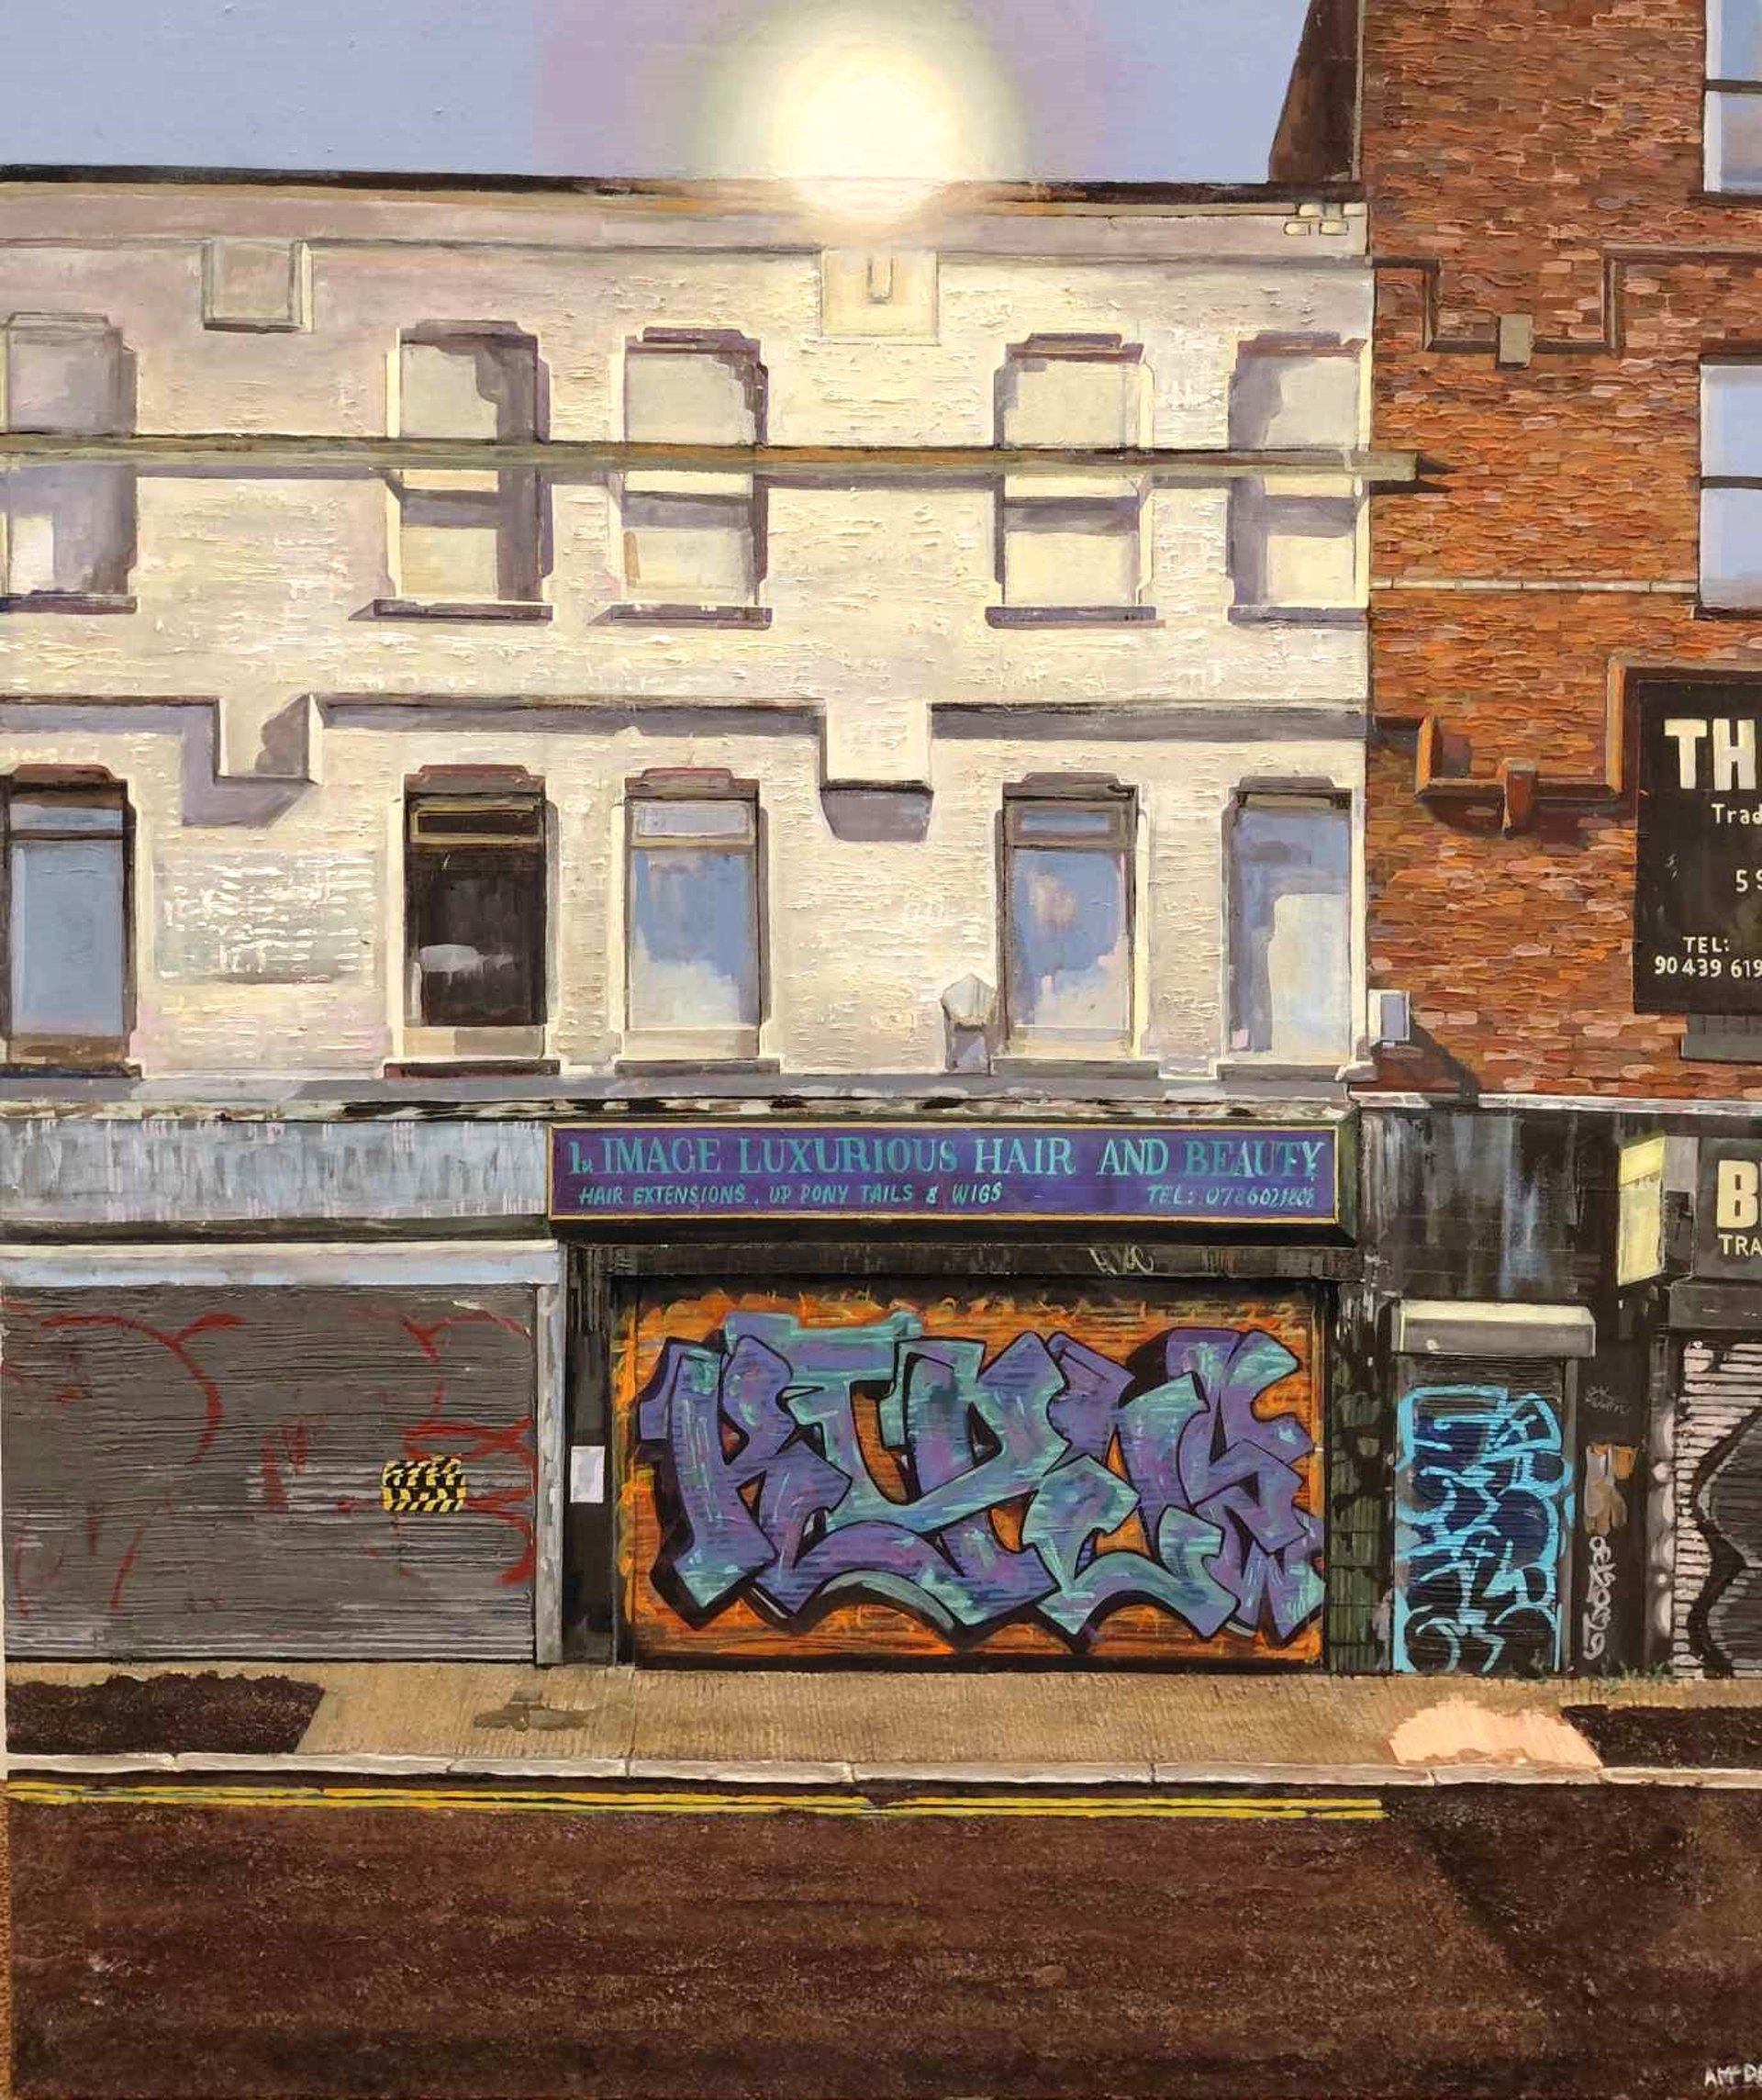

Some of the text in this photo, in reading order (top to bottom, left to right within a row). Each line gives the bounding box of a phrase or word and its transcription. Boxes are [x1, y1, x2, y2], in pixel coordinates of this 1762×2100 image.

[1664, 718, 1756, 791] TH
[1711, 803, 1762, 824] Trad
[1682, 936, 1730, 954] TEL:
[601, 1136, 721, 1175] IMAGE
[738, 1136, 959, 1175] LUXURIOUS
[975, 1137, 1076, 1176] HAIR
[1097, 1137, 1169, 1177] AND
[578, 1185, 624, 1205] HAIR
[800, 1183, 850, 1204] PONY
[860, 1183, 913, 1205] TAILS
[952, 1181, 1003, 1205] WIGS
[1717, 1160, 1762, 1228] B
[1718, 1234, 1762, 1257] TRA
